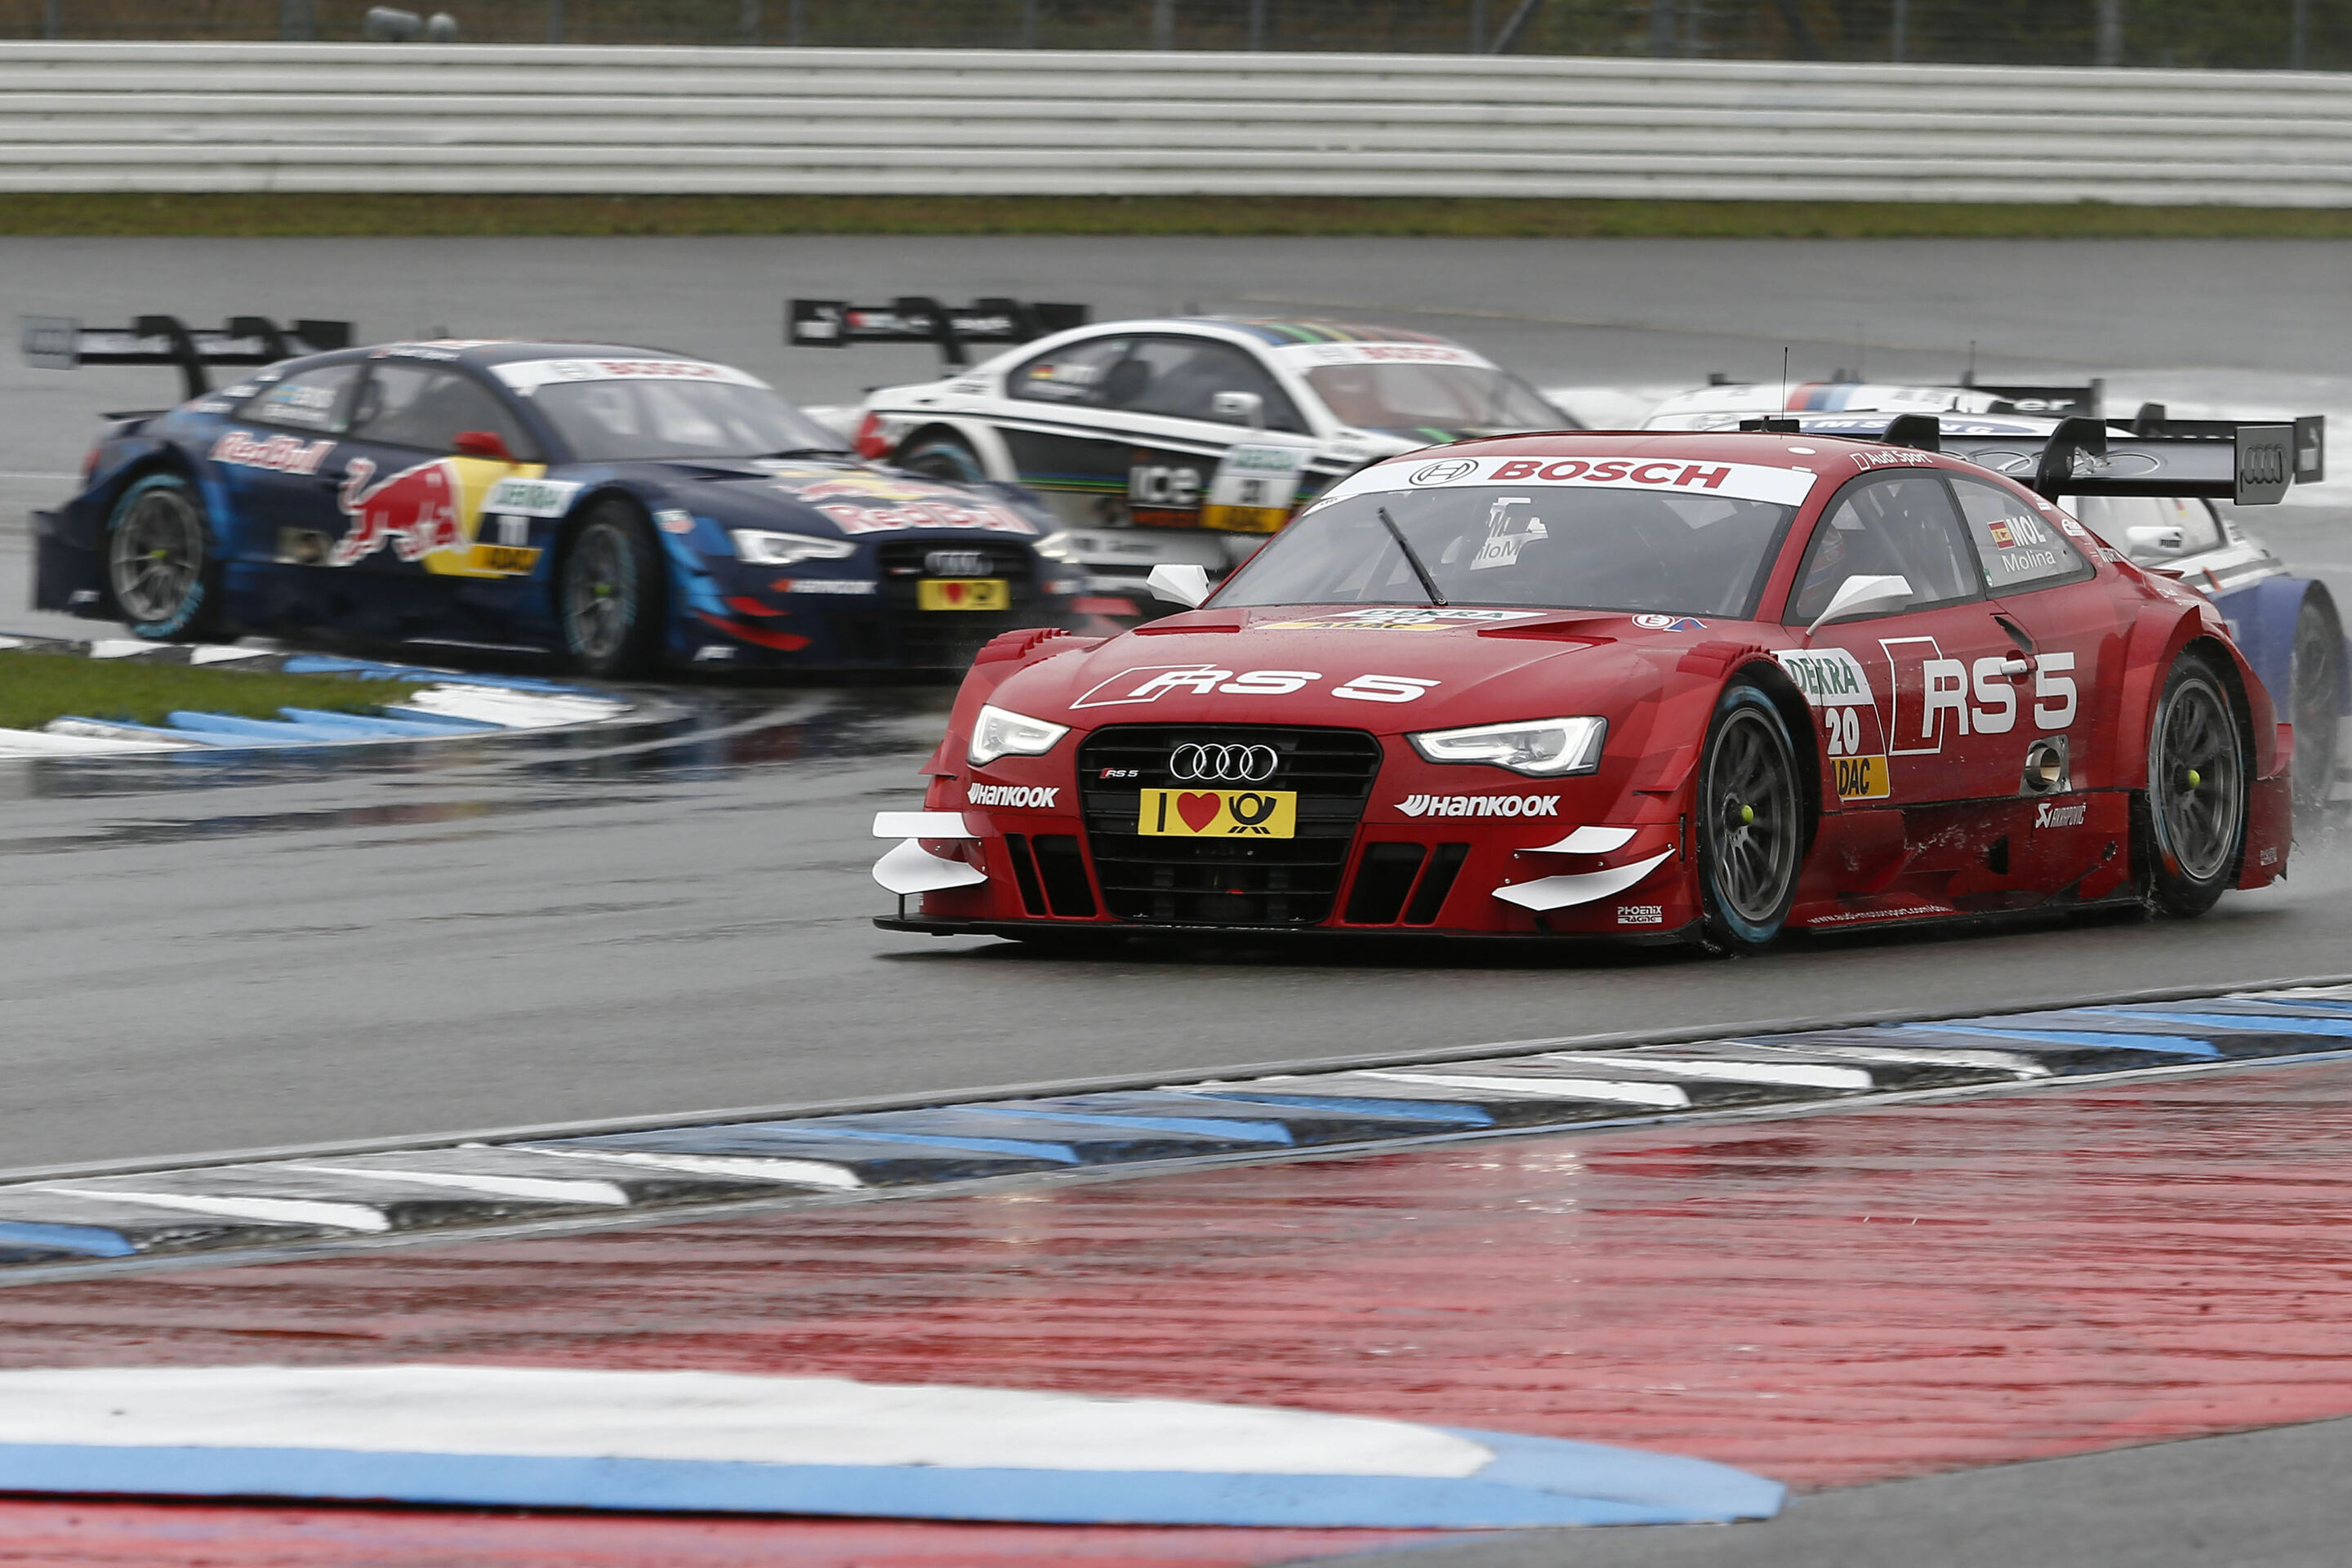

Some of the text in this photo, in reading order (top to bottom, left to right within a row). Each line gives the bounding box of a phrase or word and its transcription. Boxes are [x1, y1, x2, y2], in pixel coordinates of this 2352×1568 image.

[1864, 450, 1933, 466] Audi Sport
[1487, 461, 1731, 488] BOSCH
[2006, 515, 2047, 546] MOL
[2002, 550, 2056, 572] Molina
[1359, 609, 1503, 619] DEKRA
[1127, 670, 1442, 703] RS 5
[1784, 657, 1860, 695] DEKRA
[1922, 652, 2075, 738] RS 5
[1825, 707, 1860, 755] 20
[1105, 769, 1127, 777] RS
[1157, 792, 1167, 832] I
[1617, 906, 1663, 915] PHOENIX
